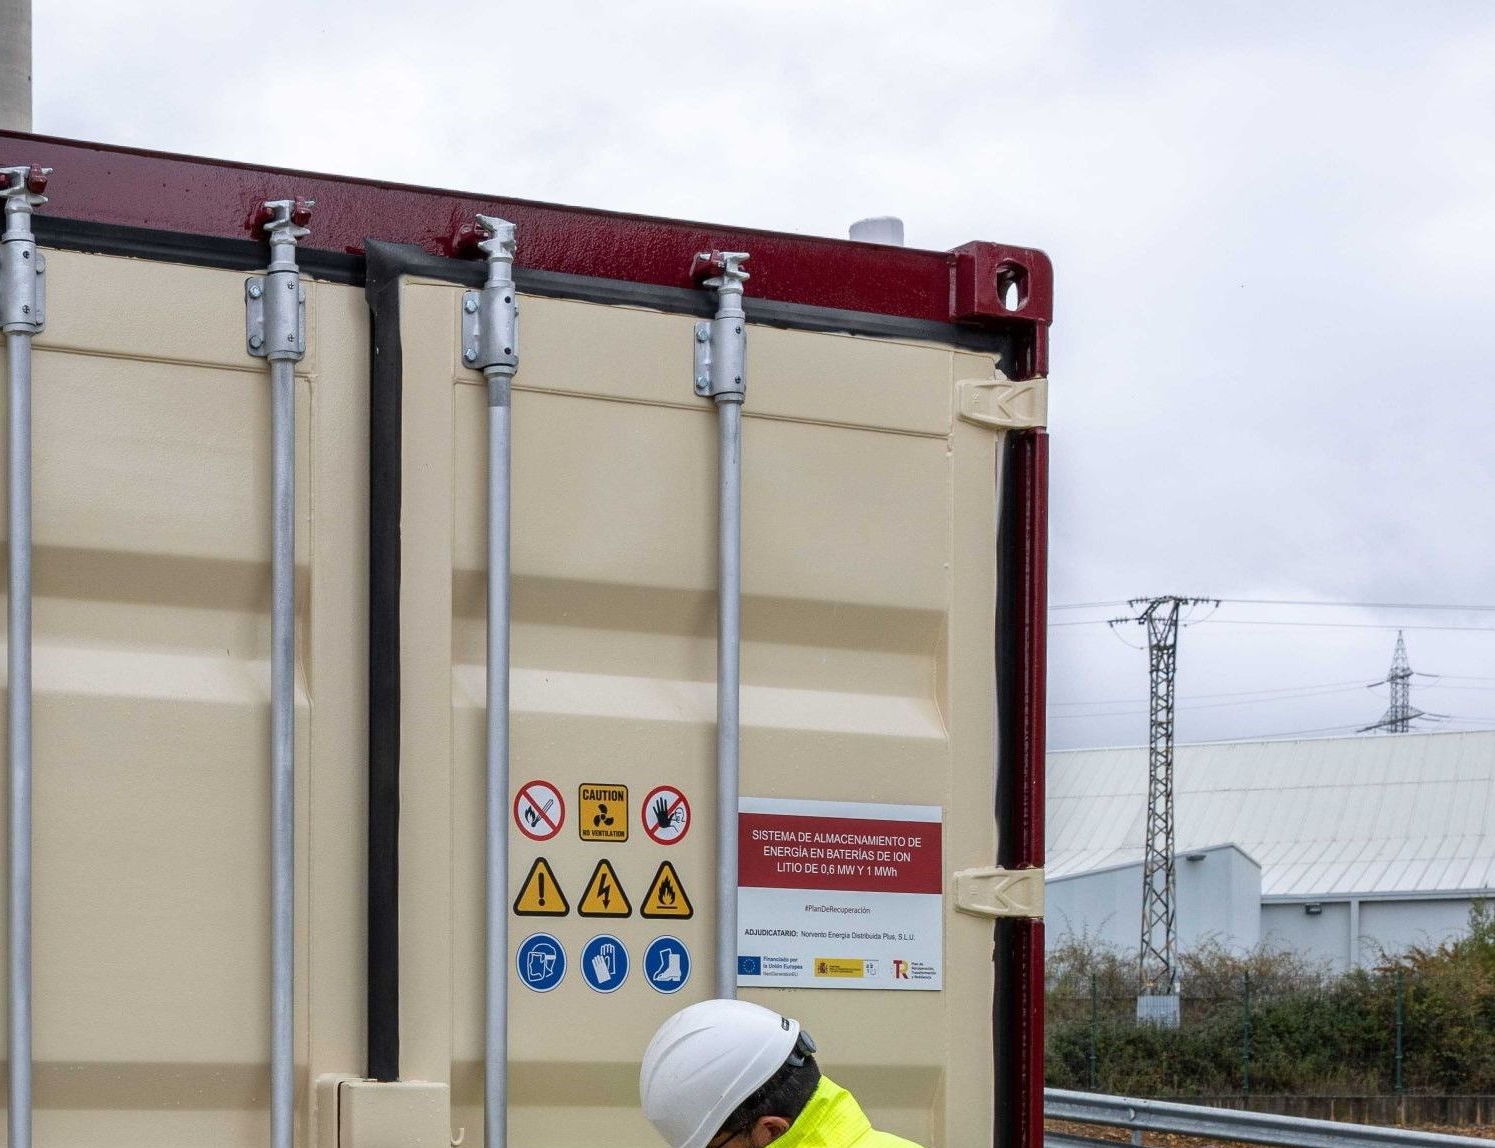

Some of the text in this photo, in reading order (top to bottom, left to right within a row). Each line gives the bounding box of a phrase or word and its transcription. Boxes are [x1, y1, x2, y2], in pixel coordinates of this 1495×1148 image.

[583, 789, 624, 802] CAUTION
[752, 830, 922, 847] SISTEMA DE ALMACENAMIENTO DE
[764, 845, 911, 862] ENERGÍA EN BATERÍAS DE ION
[777, 862, 898, 876] LITIO DE 0,6 MW Y 1 MWh
[805, 905, 871, 914] #PlanDeRecuperación
[745, 929, 799, 937] ADJUDICATARIO:
[851, 932, 881, 940] Distribuida
